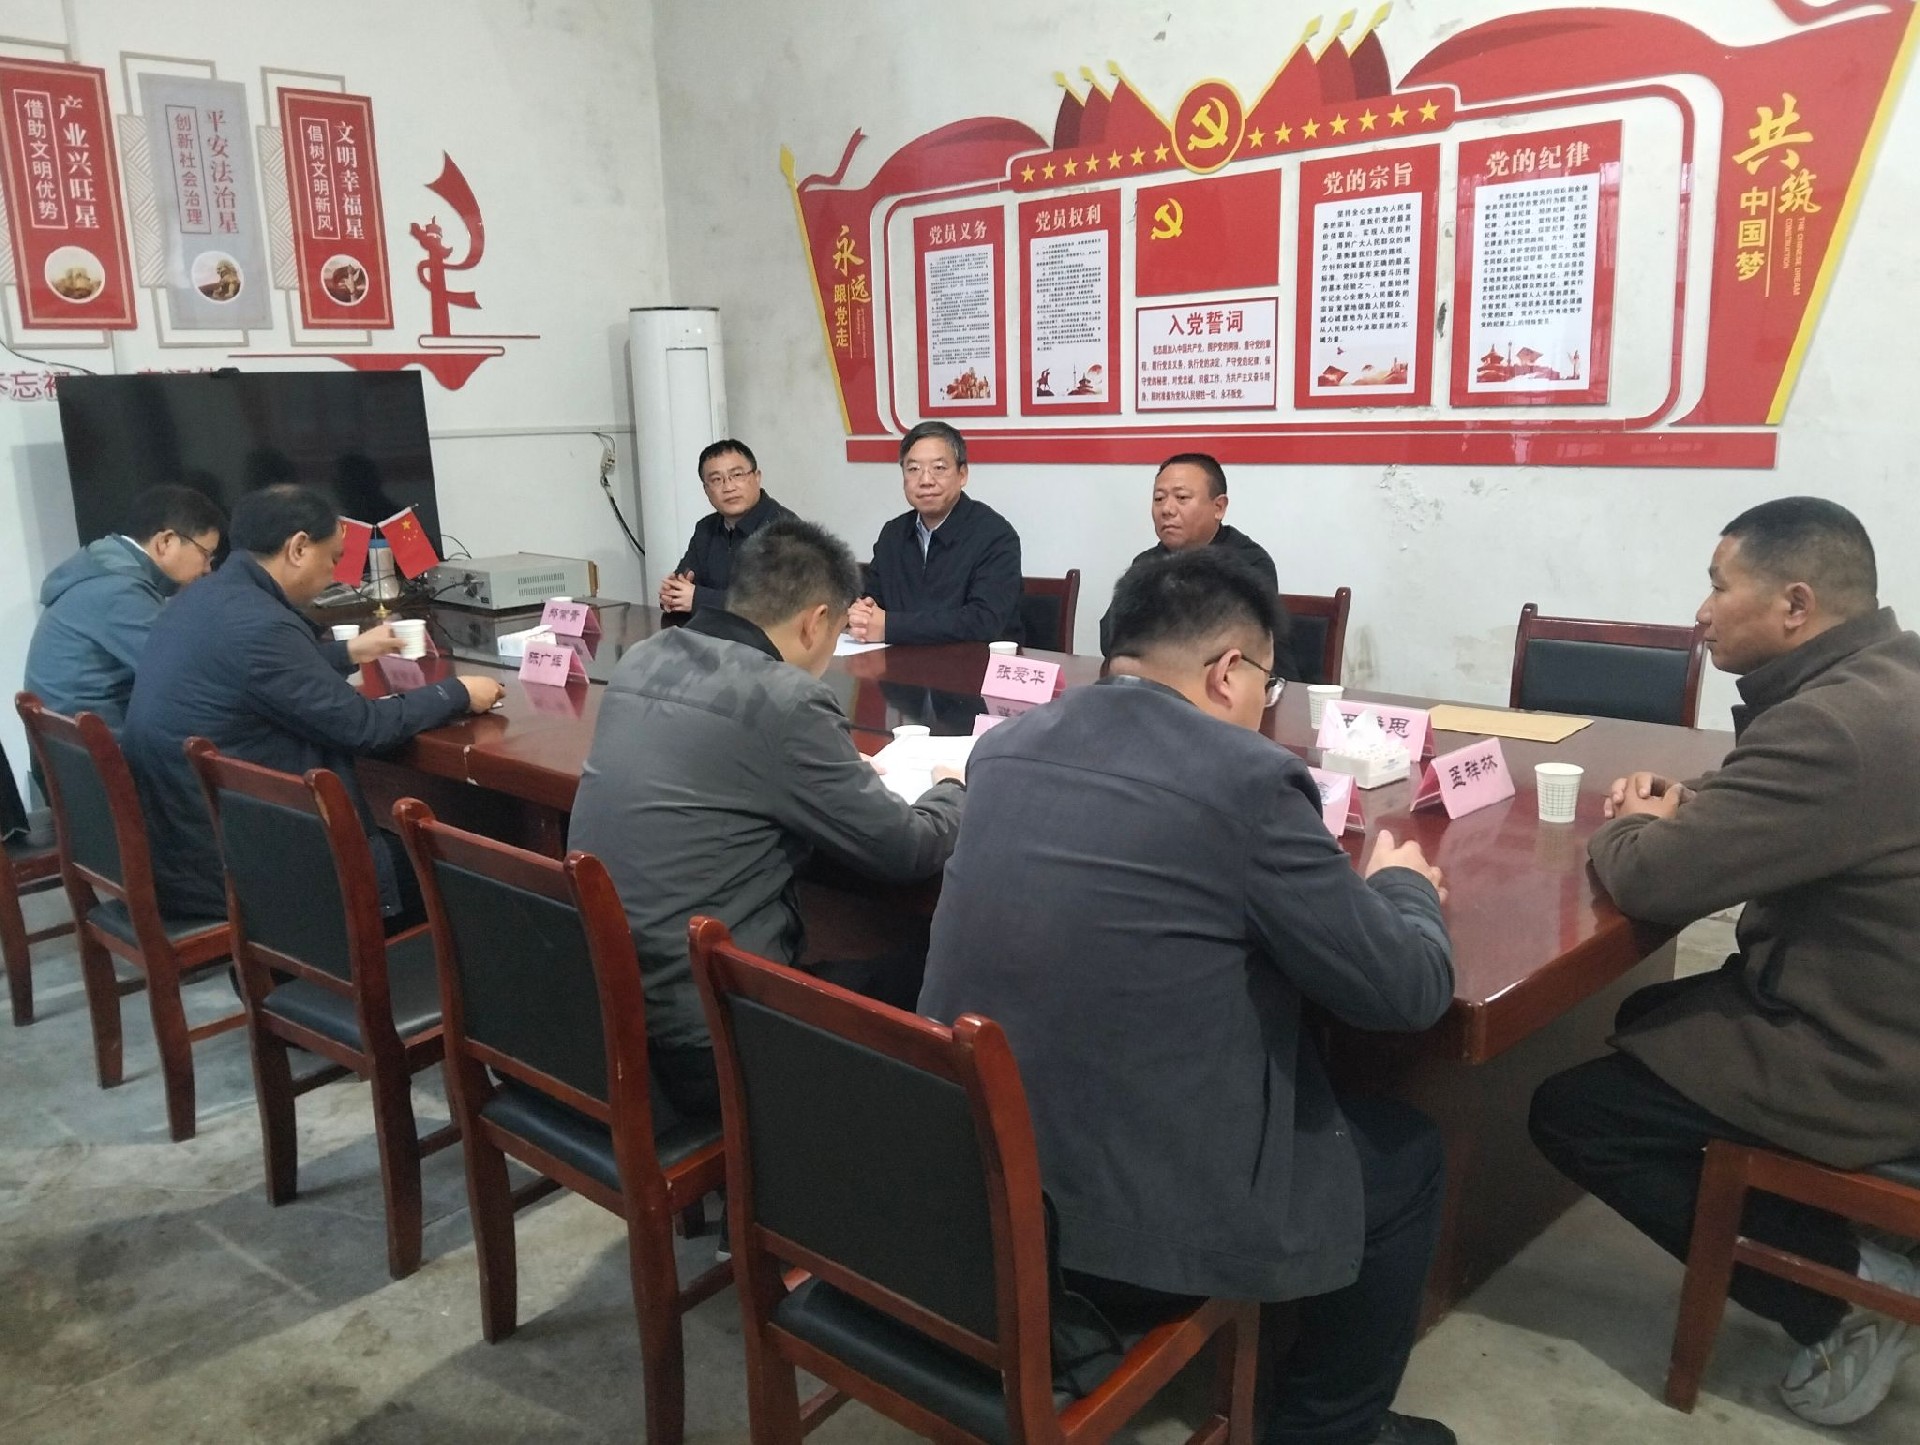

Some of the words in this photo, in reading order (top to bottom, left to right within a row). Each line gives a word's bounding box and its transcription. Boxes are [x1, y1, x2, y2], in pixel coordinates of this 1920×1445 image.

[23, 98, 59, 220] 借助文明优势
[57, 94, 100, 229] 产业兴旺星
[174, 112, 204, 225] 创新社会治理
[206, 109, 240, 234] 平安法治星
[307, 124, 333, 232] 倡树文明新风
[334, 120, 365, 239] 文明幸福星
[1323, 162, 1413, 196] 党的宗旨
[1486, 140, 1592, 179] 党的纪律
[1732, 92, 1822, 214] 共筑
[929, 219, 987, 246] 党员义务
[1035, 203, 1102, 233] 党员权利
[1735, 186, 1770, 282] 中国梦
[833, 224, 871, 303] 永远
[833, 283, 850, 348] 跟党走
[1168, 310, 1243, 336] 入党誓词
[996, 664, 1046, 685] 张爱华
[1448, 754, 1498, 789] 孟祥林
